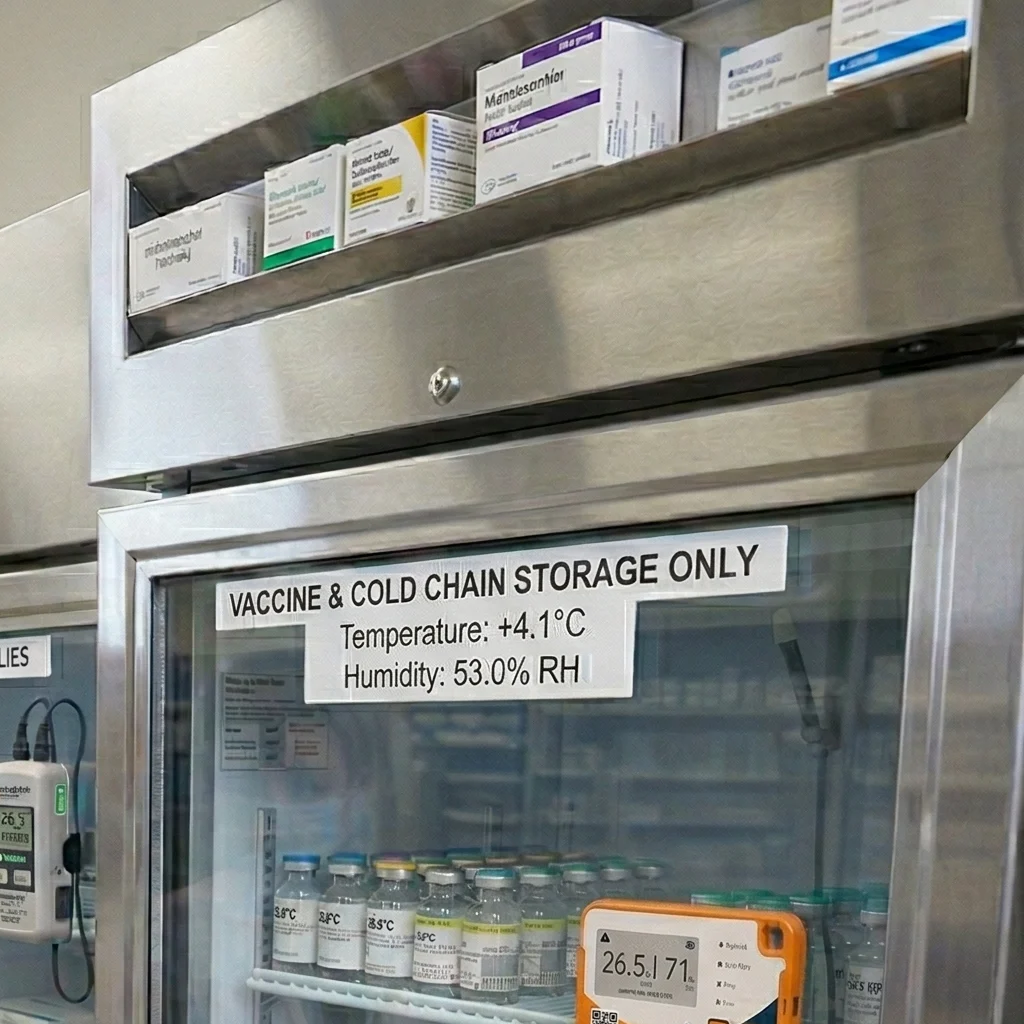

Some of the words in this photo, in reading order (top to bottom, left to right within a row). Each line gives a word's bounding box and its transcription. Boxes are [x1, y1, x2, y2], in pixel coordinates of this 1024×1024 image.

[229, 584, 322, 617] VACCINE
[328, 582, 344, 610] &
[351, 576, 417, 607] COLD
[424, 567, 505, 601] CHAIN
[513, 553, 659, 595] STORAGE
[668, 544, 760, 583] ONLY
[340, 618, 489, 654] Temperature:
[497, 607, 586, 640] +4.1°C
[344, 661, 445, 694] Humidity:
[453, 656, 530, 687] 53.0%
[539, 654, 580, 684] RH
[602, 950, 645, 978] 26.5
